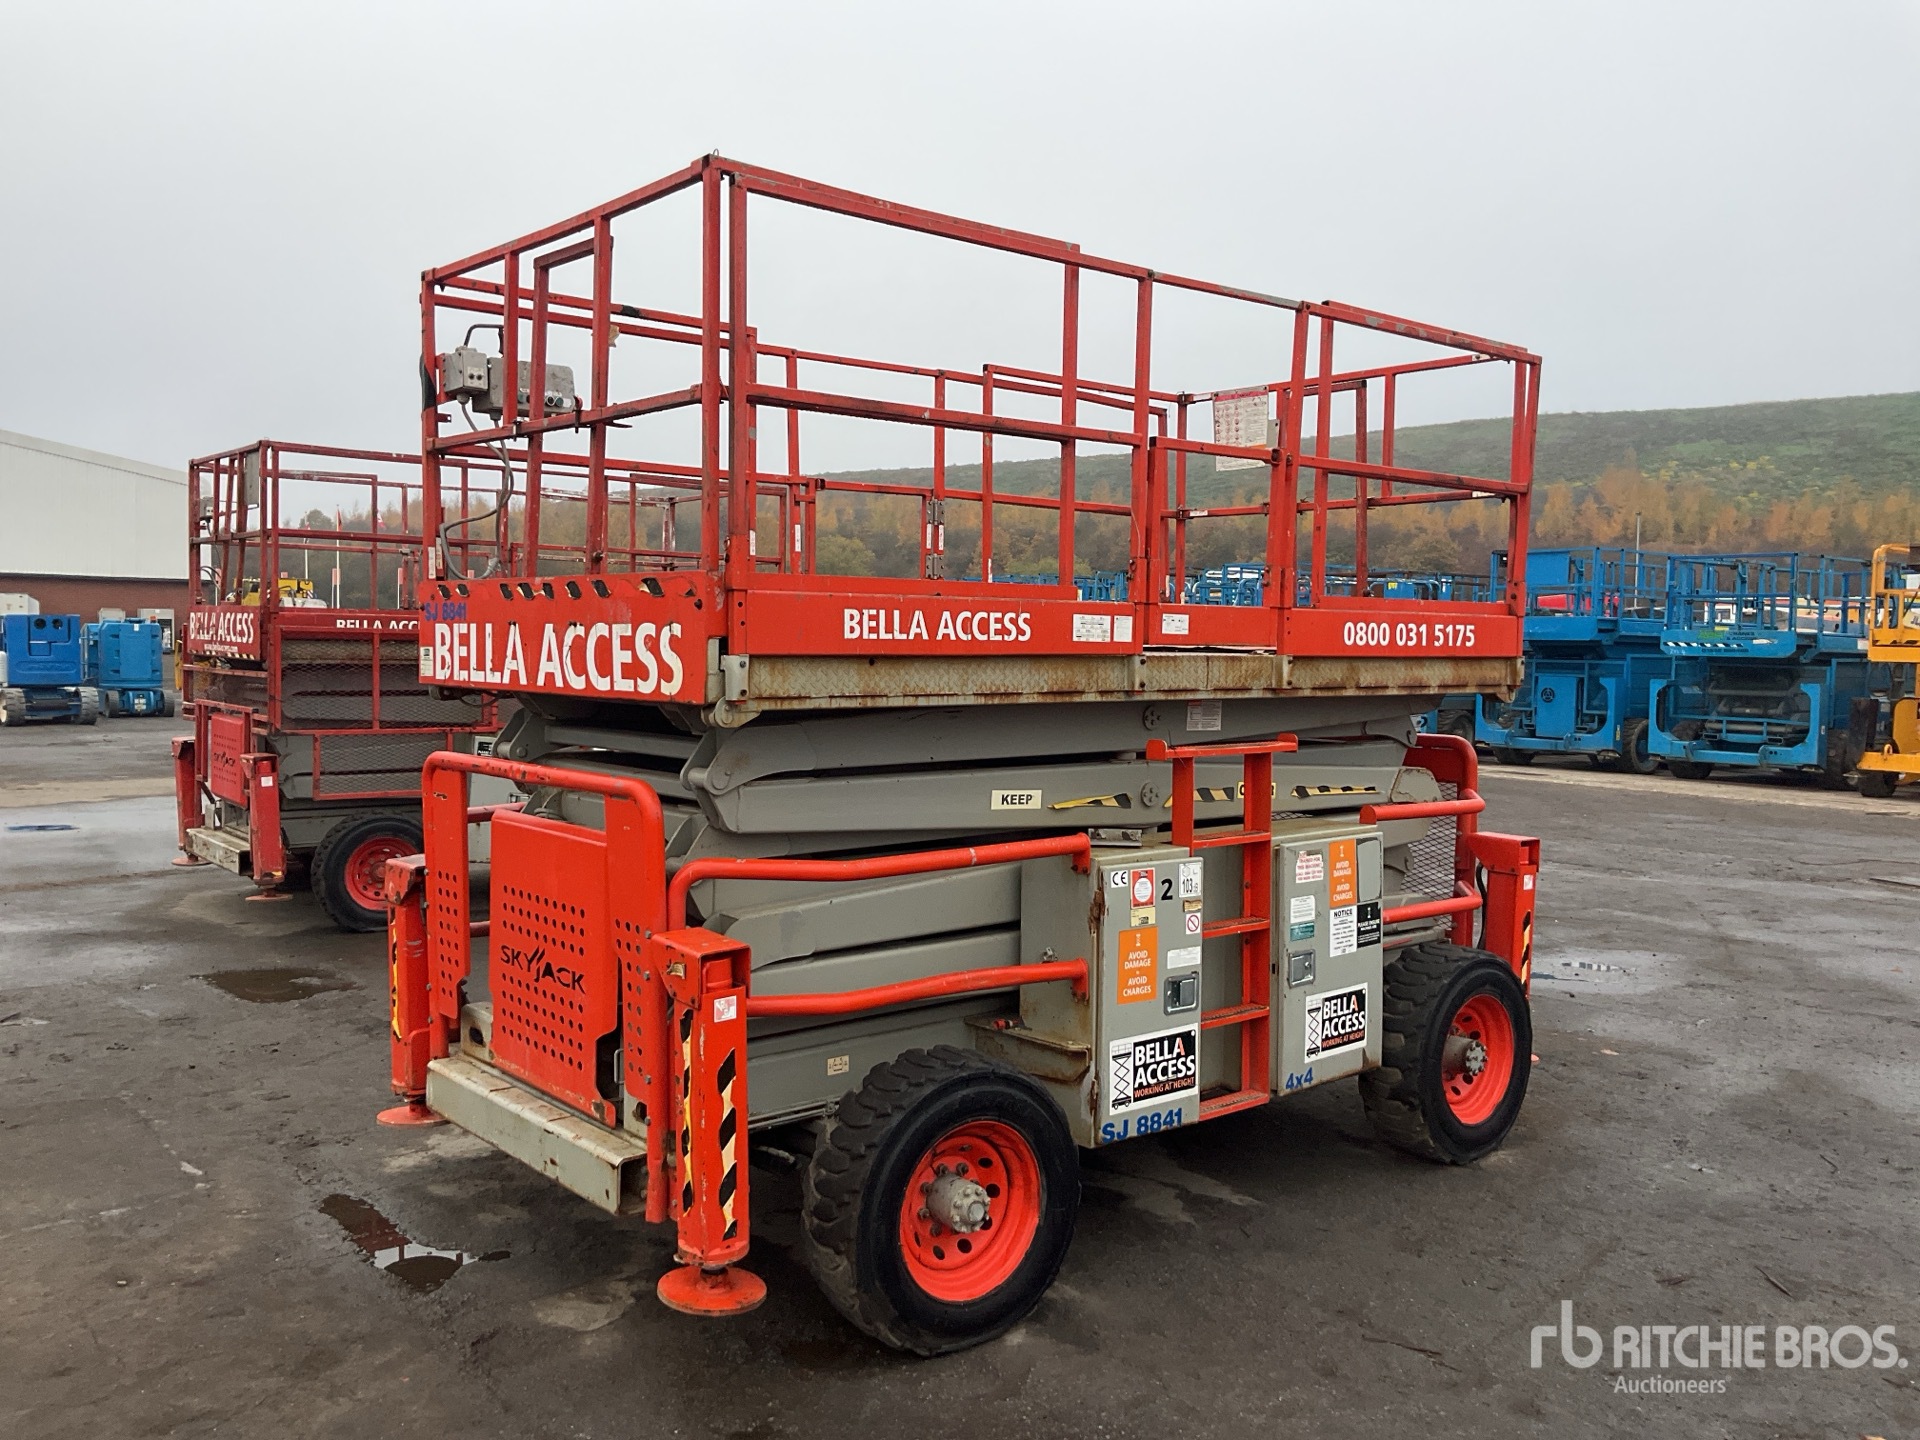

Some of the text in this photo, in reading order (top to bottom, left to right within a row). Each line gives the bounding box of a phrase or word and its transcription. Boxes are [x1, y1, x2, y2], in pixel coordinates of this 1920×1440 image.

[425, 602, 438, 621] SJ
[189, 611, 254, 643] BELLA ACCESS
[389, 620, 420, 630] ACC
[843, 608, 1032, 642] BELLA ACCESS
[1343, 621, 1476, 647] 0800 031 5175
[434, 622, 528, 686] BELLA
[536, 621, 684, 696] ACCESS
[1000, 793, 1034, 806] KEEP
[1160, 878, 1173, 901] 2
[1182, 878, 1193, 893] 103
[1333, 908, 1353, 917] NOTICE
[1124, 958, 1152, 970] DAMAGE
[1128, 950, 1148, 960] AVOID
[500, 943, 586, 994] SKYJACK
[1122, 985, 1152, 997] CHARGES
[1127, 975, 1148, 986] AVOID
[1323, 994, 1358, 1020] BELLA
[1322, 1010, 1366, 1039] ACCESS
[1134, 1037, 1186, 1067] BELLA
[1321, 1036, 1343, 1048] WORKING
[1134, 1054, 1196, 1088] ACCESS
[1285, 1066, 1314, 1090] 4x4
[1133, 1076, 1195, 1098] WORKING AT HEIGHT
[1101, 1107, 1183, 1143] SJ 8841
